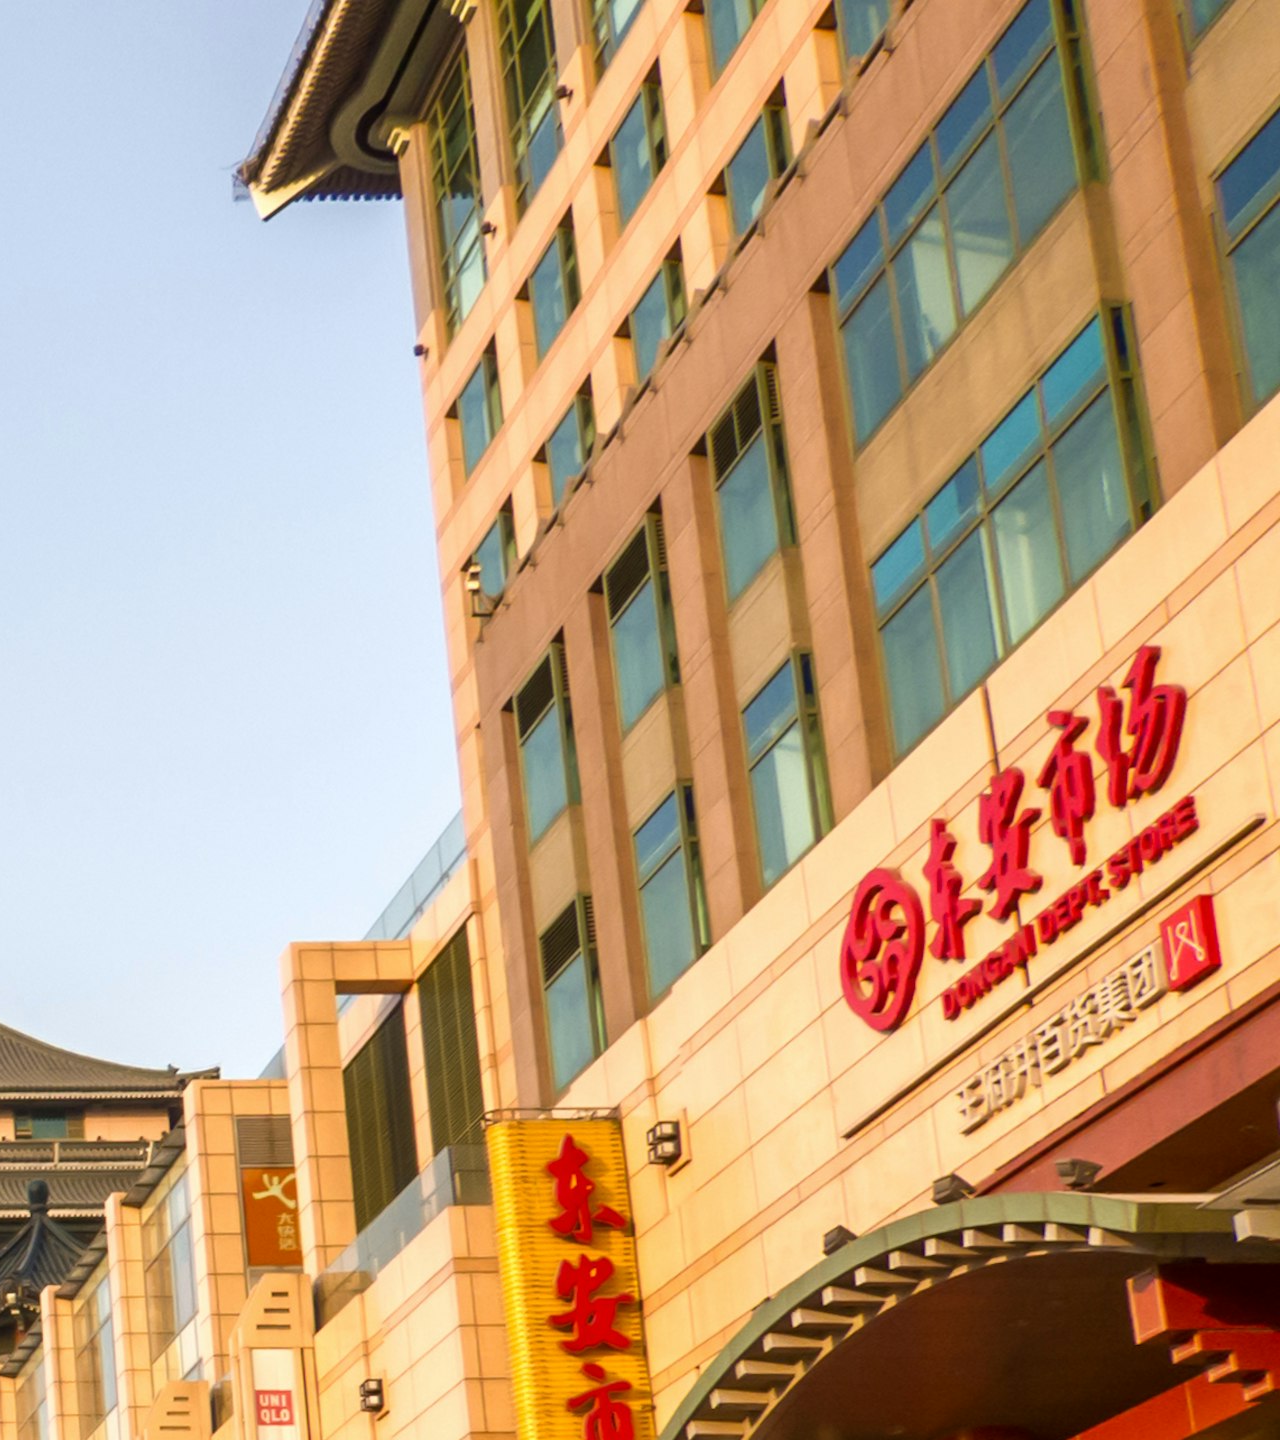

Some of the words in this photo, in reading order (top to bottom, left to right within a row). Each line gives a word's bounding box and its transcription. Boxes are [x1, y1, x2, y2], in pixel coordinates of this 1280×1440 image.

[942, 923, 1038, 1020] DONGAN
[1107, 796, 1199, 889] STORE
[957, 941, 1170, 1135] 王府井百货集团
[259, 1394, 287, 1407] UNI
[260, 1408, 291, 1424] QLO
